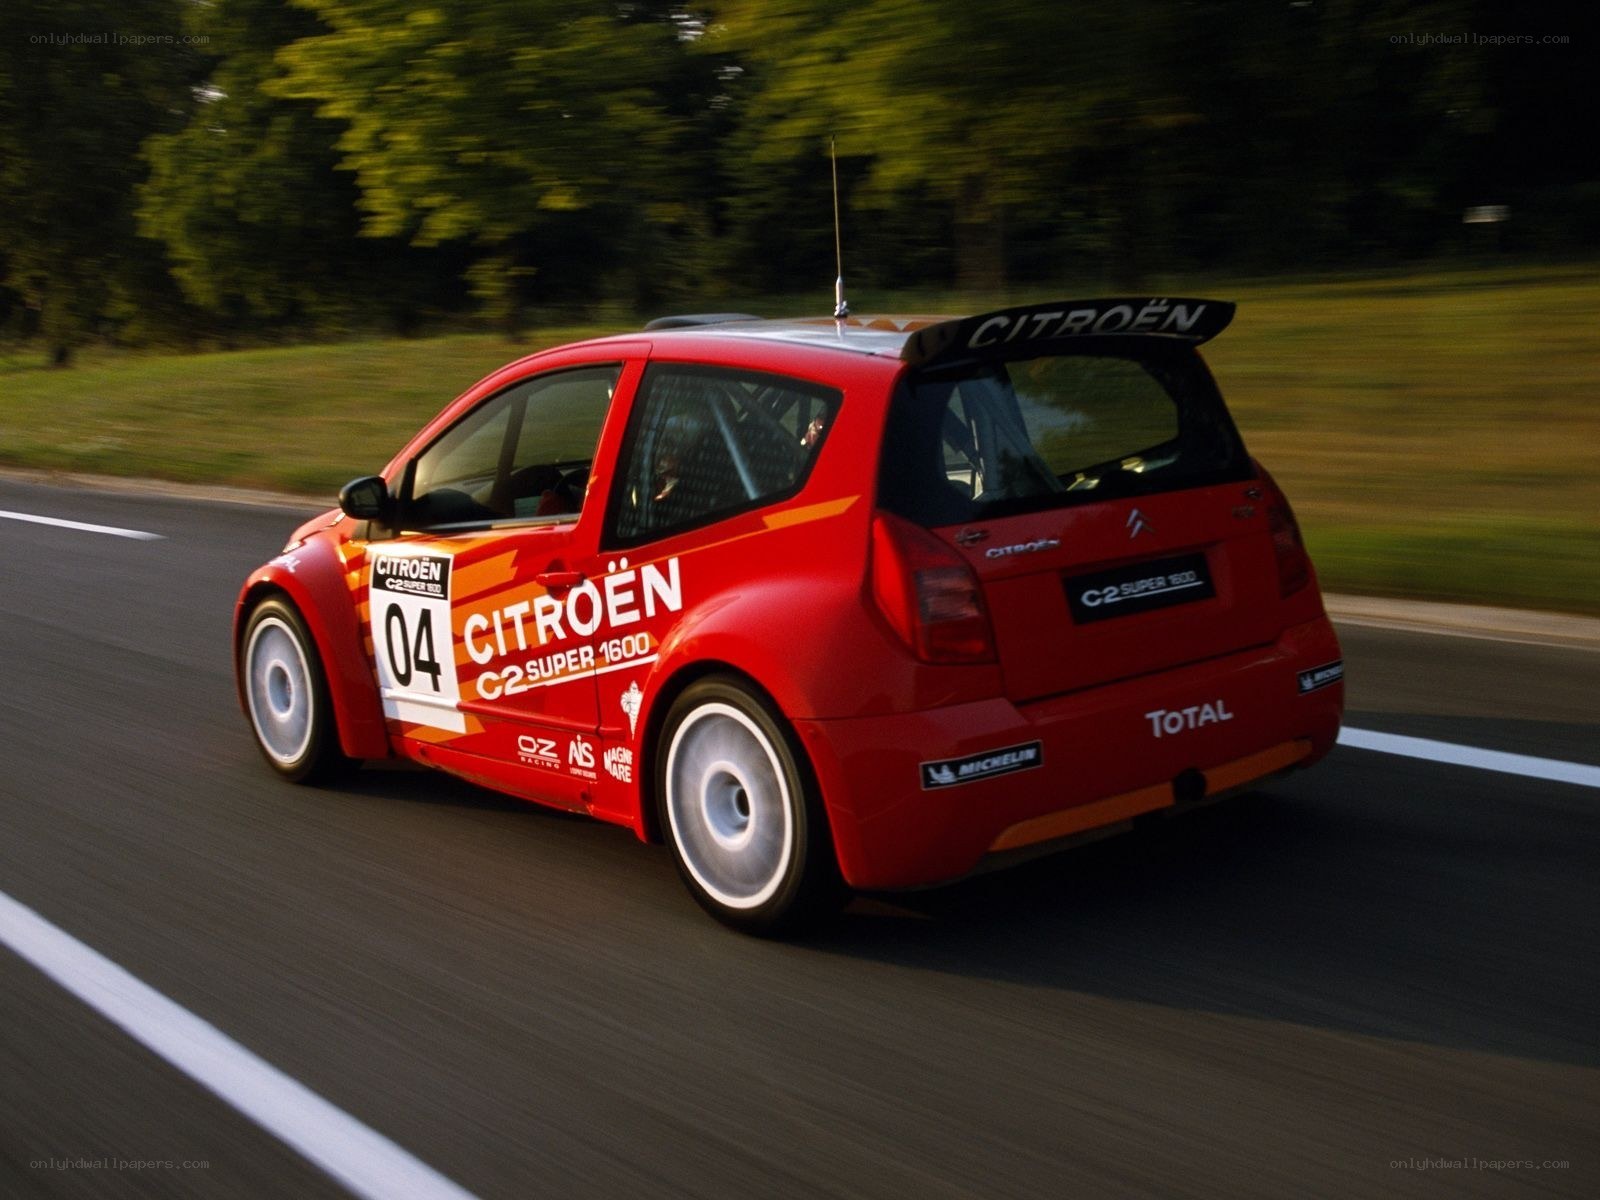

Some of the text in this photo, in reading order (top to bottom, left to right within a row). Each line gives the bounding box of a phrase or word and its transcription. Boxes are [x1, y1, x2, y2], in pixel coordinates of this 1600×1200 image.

[968, 298, 1207, 348] CITROËN
[376, 555, 442, 581] CITROËN
[385, 578, 404, 591] C2
[403, 580, 426, 591] SUPER
[1081, 586, 1120, 607] C2
[1120, 576, 1166, 595] SUPER
[464, 557, 682, 665] CITROËN
[385, 603, 441, 692] 04
[476, 632, 650, 700] C2 SUPER 1600
[1144, 699, 1234, 738] TOTAL
[520, 756, 560, 769] RACING
[959, 747, 1037, 775] MICHELIN
